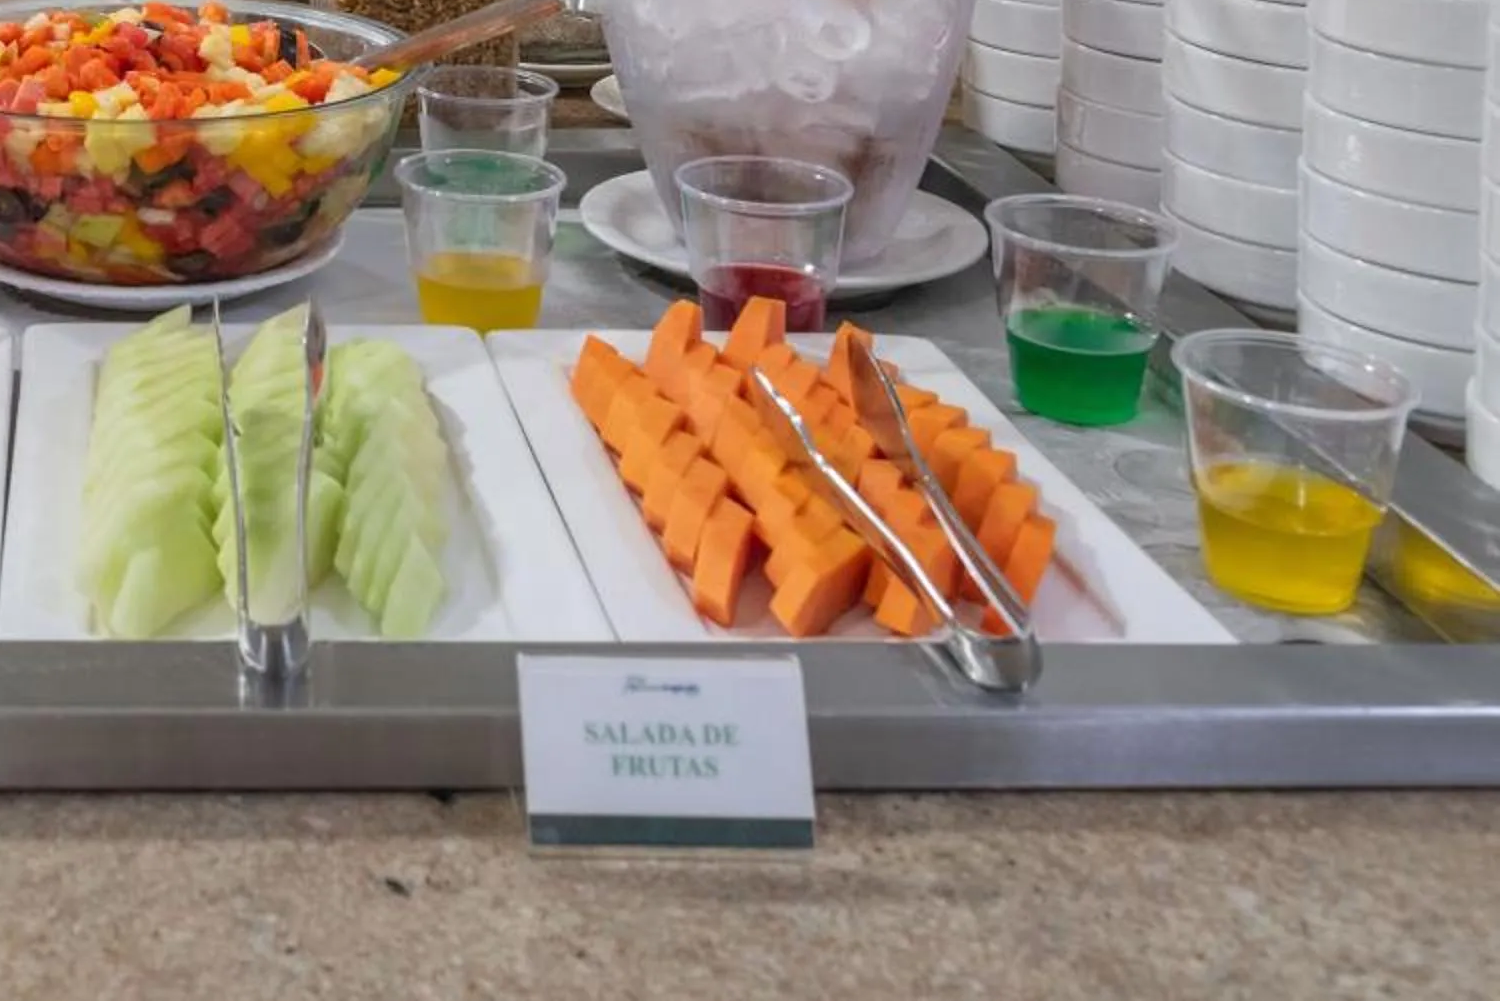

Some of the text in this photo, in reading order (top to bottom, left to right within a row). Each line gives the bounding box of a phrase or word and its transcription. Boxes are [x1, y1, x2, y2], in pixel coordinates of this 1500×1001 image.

[583, 720, 740, 746] SALADA DE
[611, 754, 719, 778] FRUTAS
